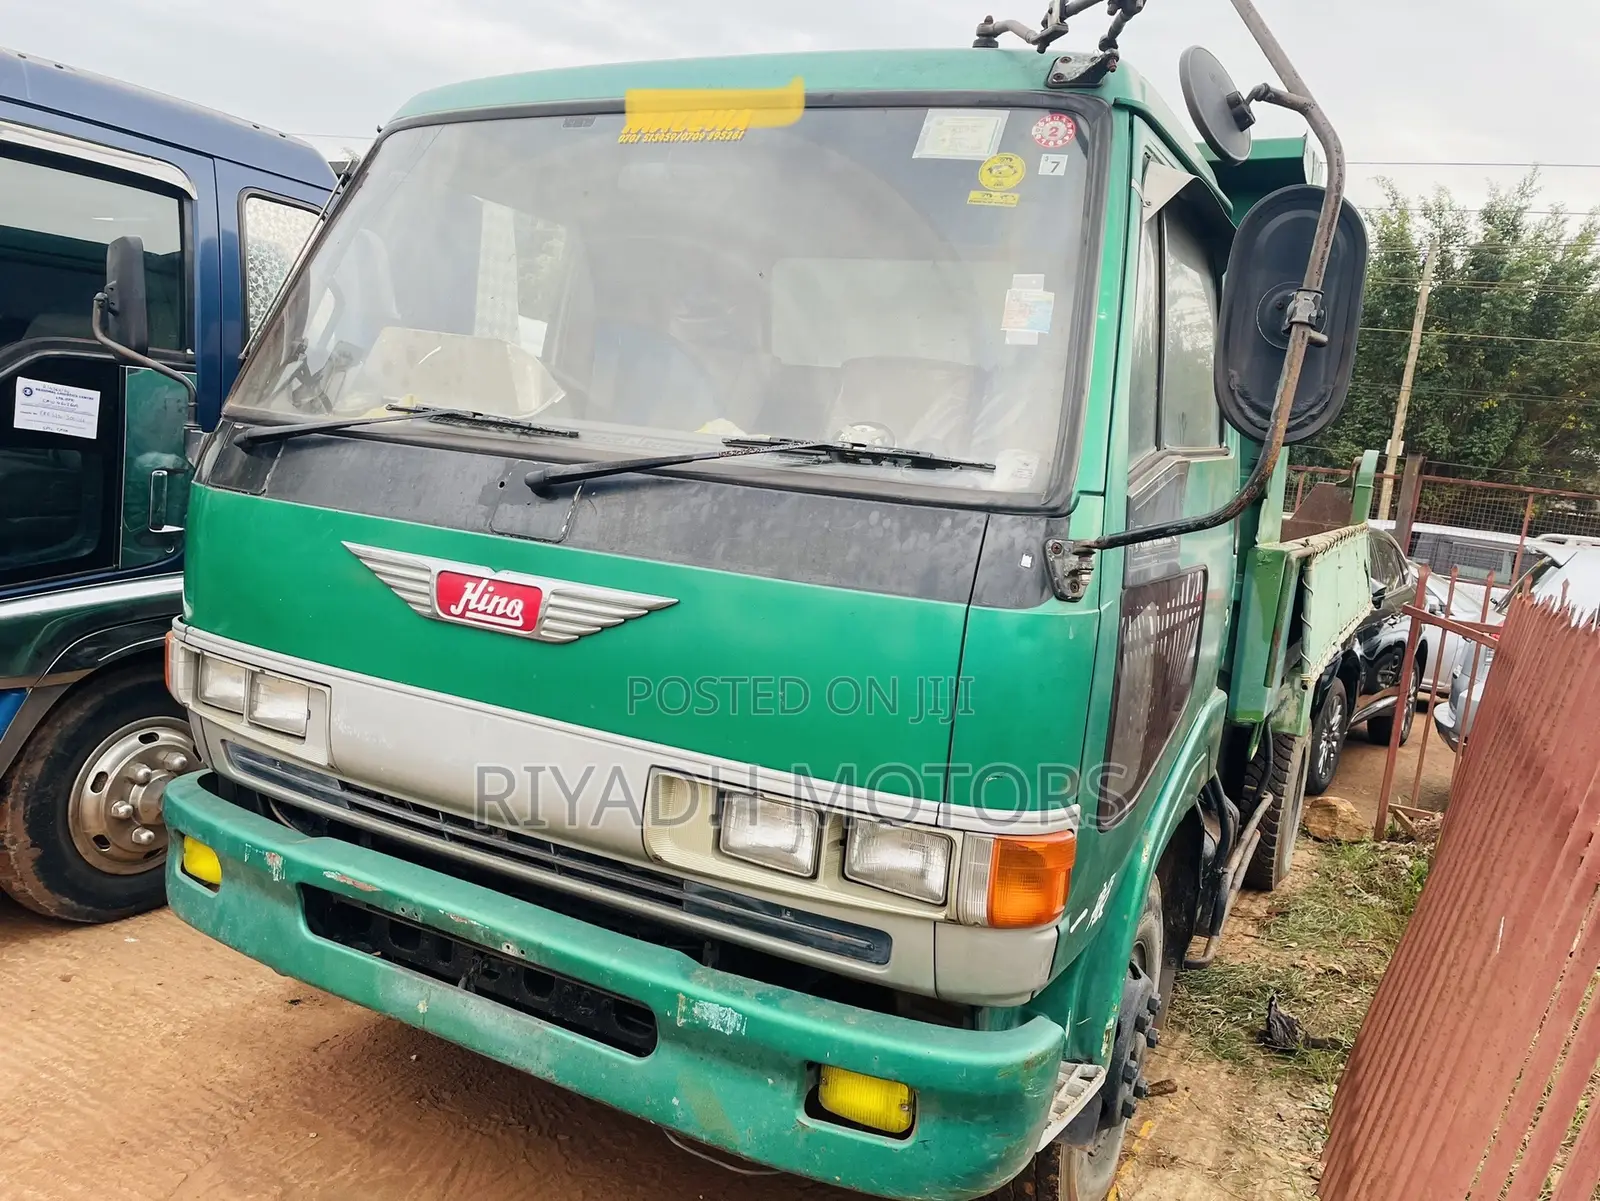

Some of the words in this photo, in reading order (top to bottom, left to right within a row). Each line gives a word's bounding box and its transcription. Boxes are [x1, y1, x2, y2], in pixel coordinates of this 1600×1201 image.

[1048, 126, 1059, 137] 2
[1050, 161, 1060, 174] 7
[450, 579, 524, 627] Hino
